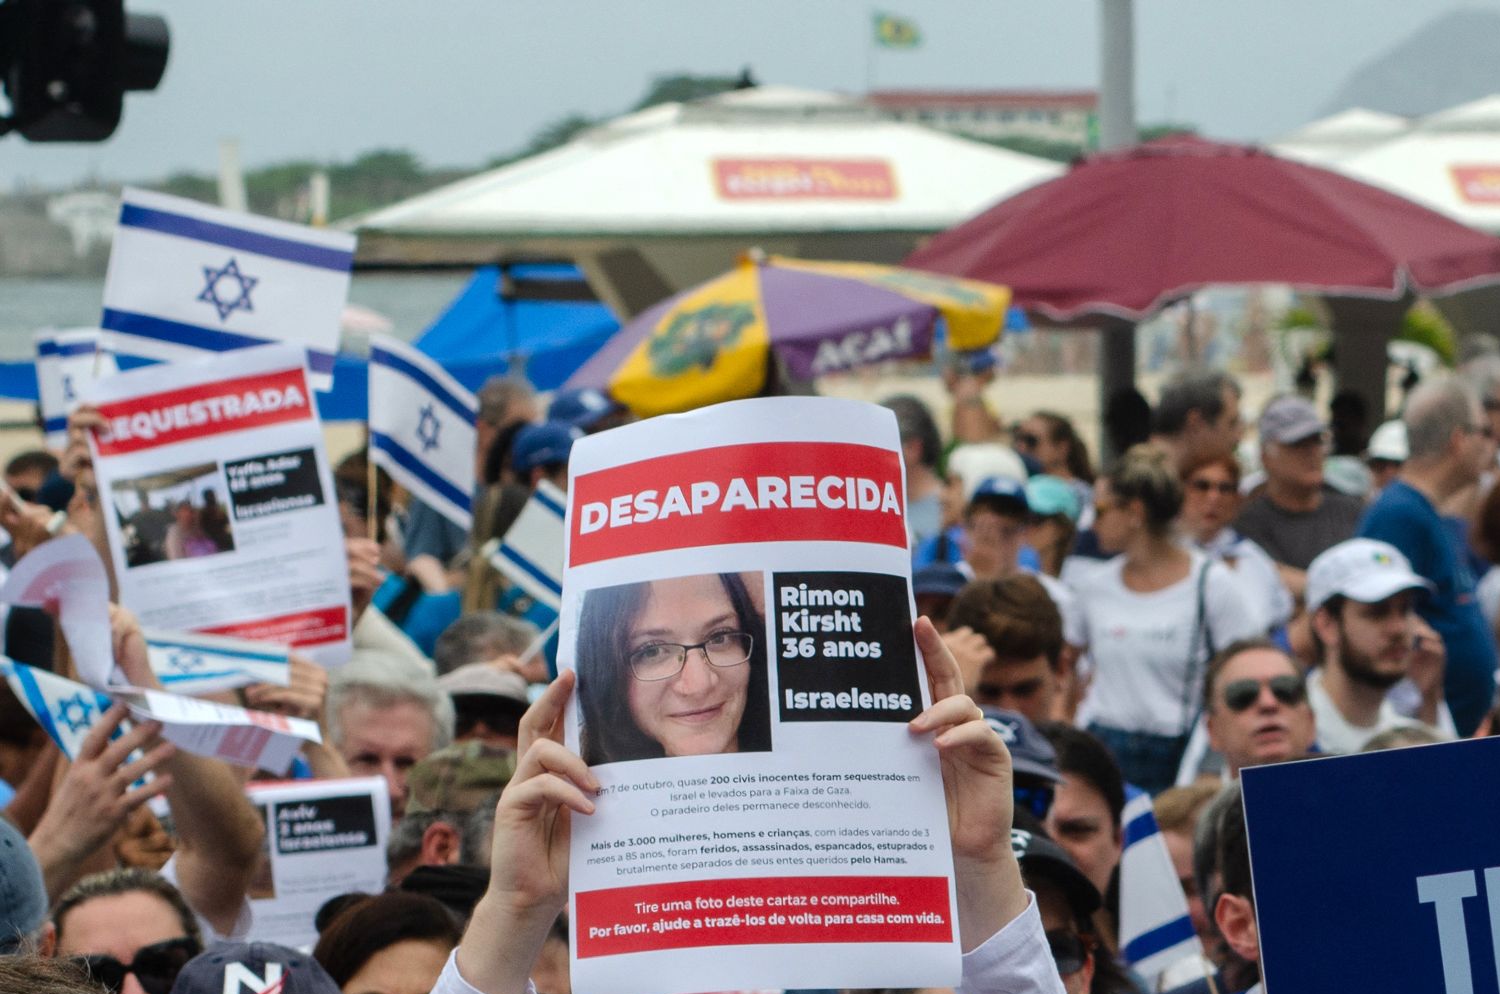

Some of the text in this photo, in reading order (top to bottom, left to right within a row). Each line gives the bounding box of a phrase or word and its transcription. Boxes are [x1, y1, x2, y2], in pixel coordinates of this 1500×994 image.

[579, 476, 902, 535] DESAPARECIDA
[780, 583, 865, 607] Rimon
[782, 610, 862, 633] Kirsht
[782, 637, 882, 659] 36 anos
[785, 687, 913, 711] Israelense
[617, 784, 630, 793] de
[632, 780, 675, 791] outubro,
[677, 777, 708, 789] quase
[710, 775, 730, 785] 200
[732, 773, 756, 784] civis
[758, 773, 810, 783] inocentes
[812, 772, 842, 782] foram
[843, 772, 906, 784] sequestrados
[670, 791, 697, 802] Israel
[707, 788, 747, 799] levados
[749, 789, 772, 798] para
[783, 787, 810, 796] Faixa
[812, 786, 825, 795] de
[650, 800, 872, 817] O paradeiro deles permanece desconhecido.
[591, 840, 612, 851] Mais
[613, 838, 626, 848] de
[627, 836, 656, 847] 3.000
[658, 833, 711, 845] mulheres,
[713, 830, 756, 840] homens
[767, 829, 812, 839] crianças,
[838, 828, 870, 837] idades
[871, 828, 910, 837] variando
[912, 828, 923, 837] de
[923, 829, 930, 837] 3
[586, 856, 615, 865] meses
[625, 852, 638, 861] 85
[639, 851, 666, 861] anos,
[667, 848, 698, 857] foram
[700, 845, 740, 855] feridos,
[742, 842, 813, 853] assassinados,
[815, 842, 875, 853] espancados,
[877, 842, 928, 852] estuprados
[616, 855, 908, 875] brutalmente separados de seus entes queridos pelo Hamas.
[634, 893, 900, 914] Tire uma foto deste cartaz e compartilhe.
[589, 911, 945, 939] Por favor, ajude a trazê-los de volta para casa com vida.
